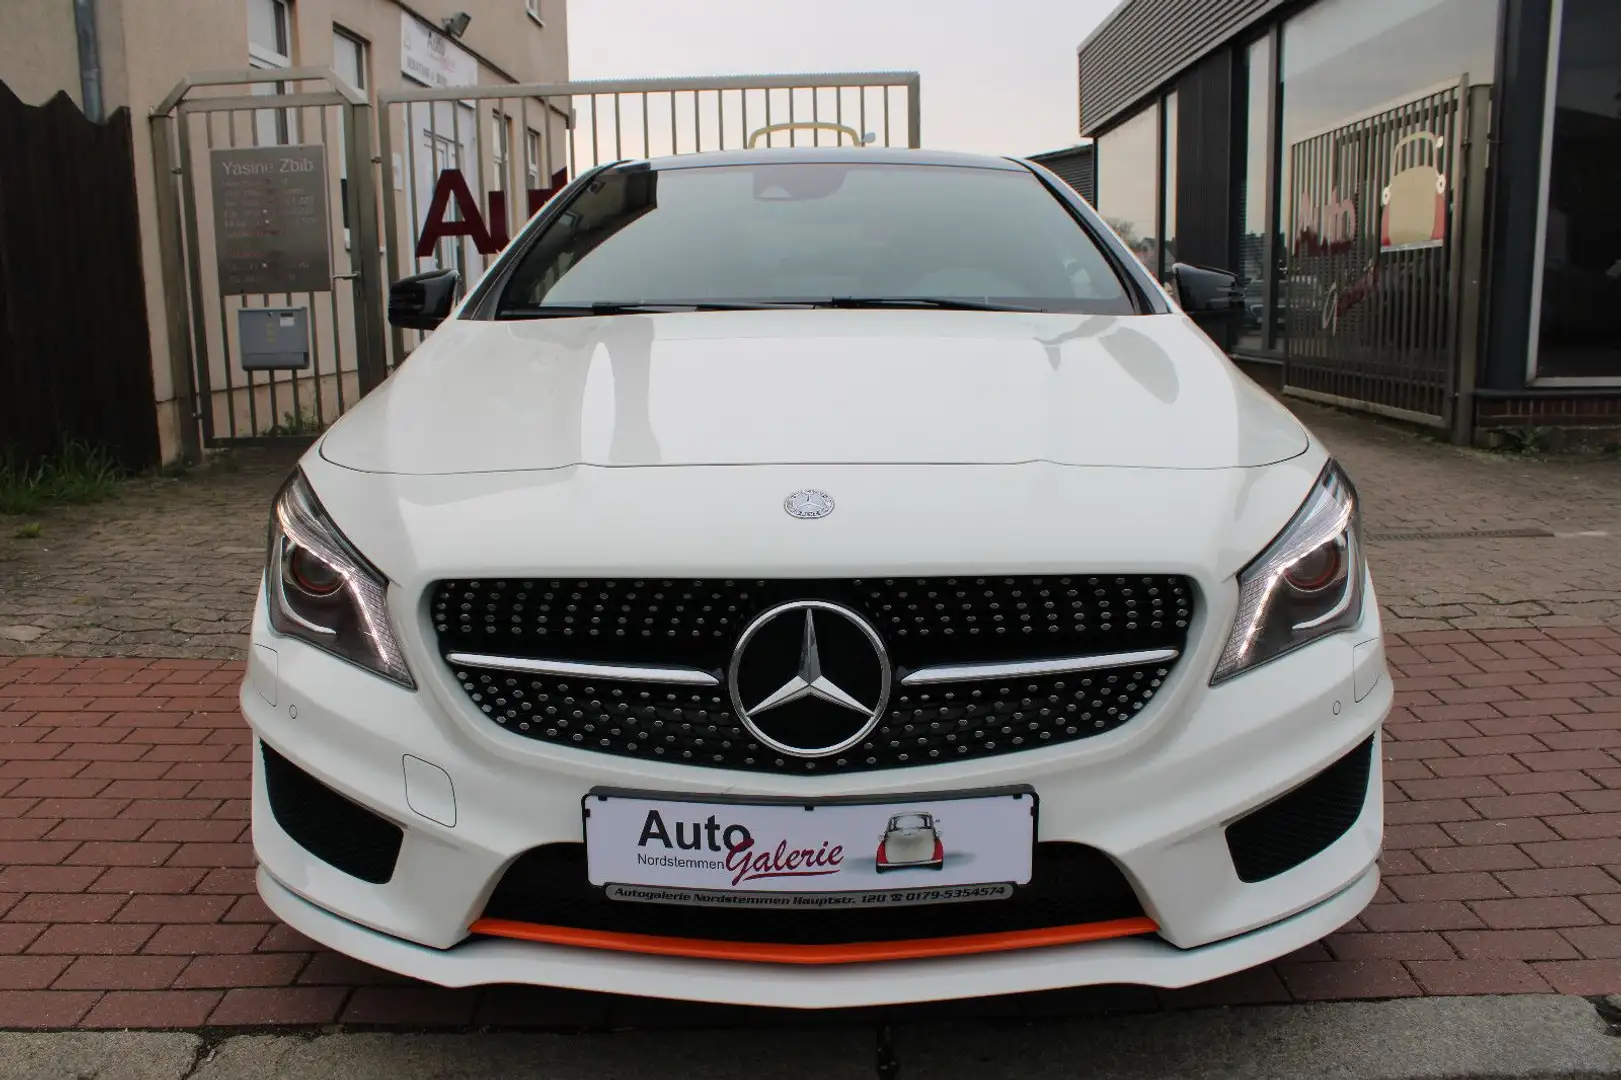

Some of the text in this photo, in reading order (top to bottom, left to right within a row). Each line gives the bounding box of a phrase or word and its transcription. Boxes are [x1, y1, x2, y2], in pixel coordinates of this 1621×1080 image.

[221, 157, 315, 176] Yasine Zbib
[637, 809, 751, 852] Auto
[637, 853, 725, 870] Nordstemmen
[726, 839, 844, 886] Galerie
[614, 887, 691, 901] Autogalerie
[693, 892, 790, 905] Nordstemmen
[792, 895, 855, 907] Hauptstr.
[861, 894, 886, 904] 120
